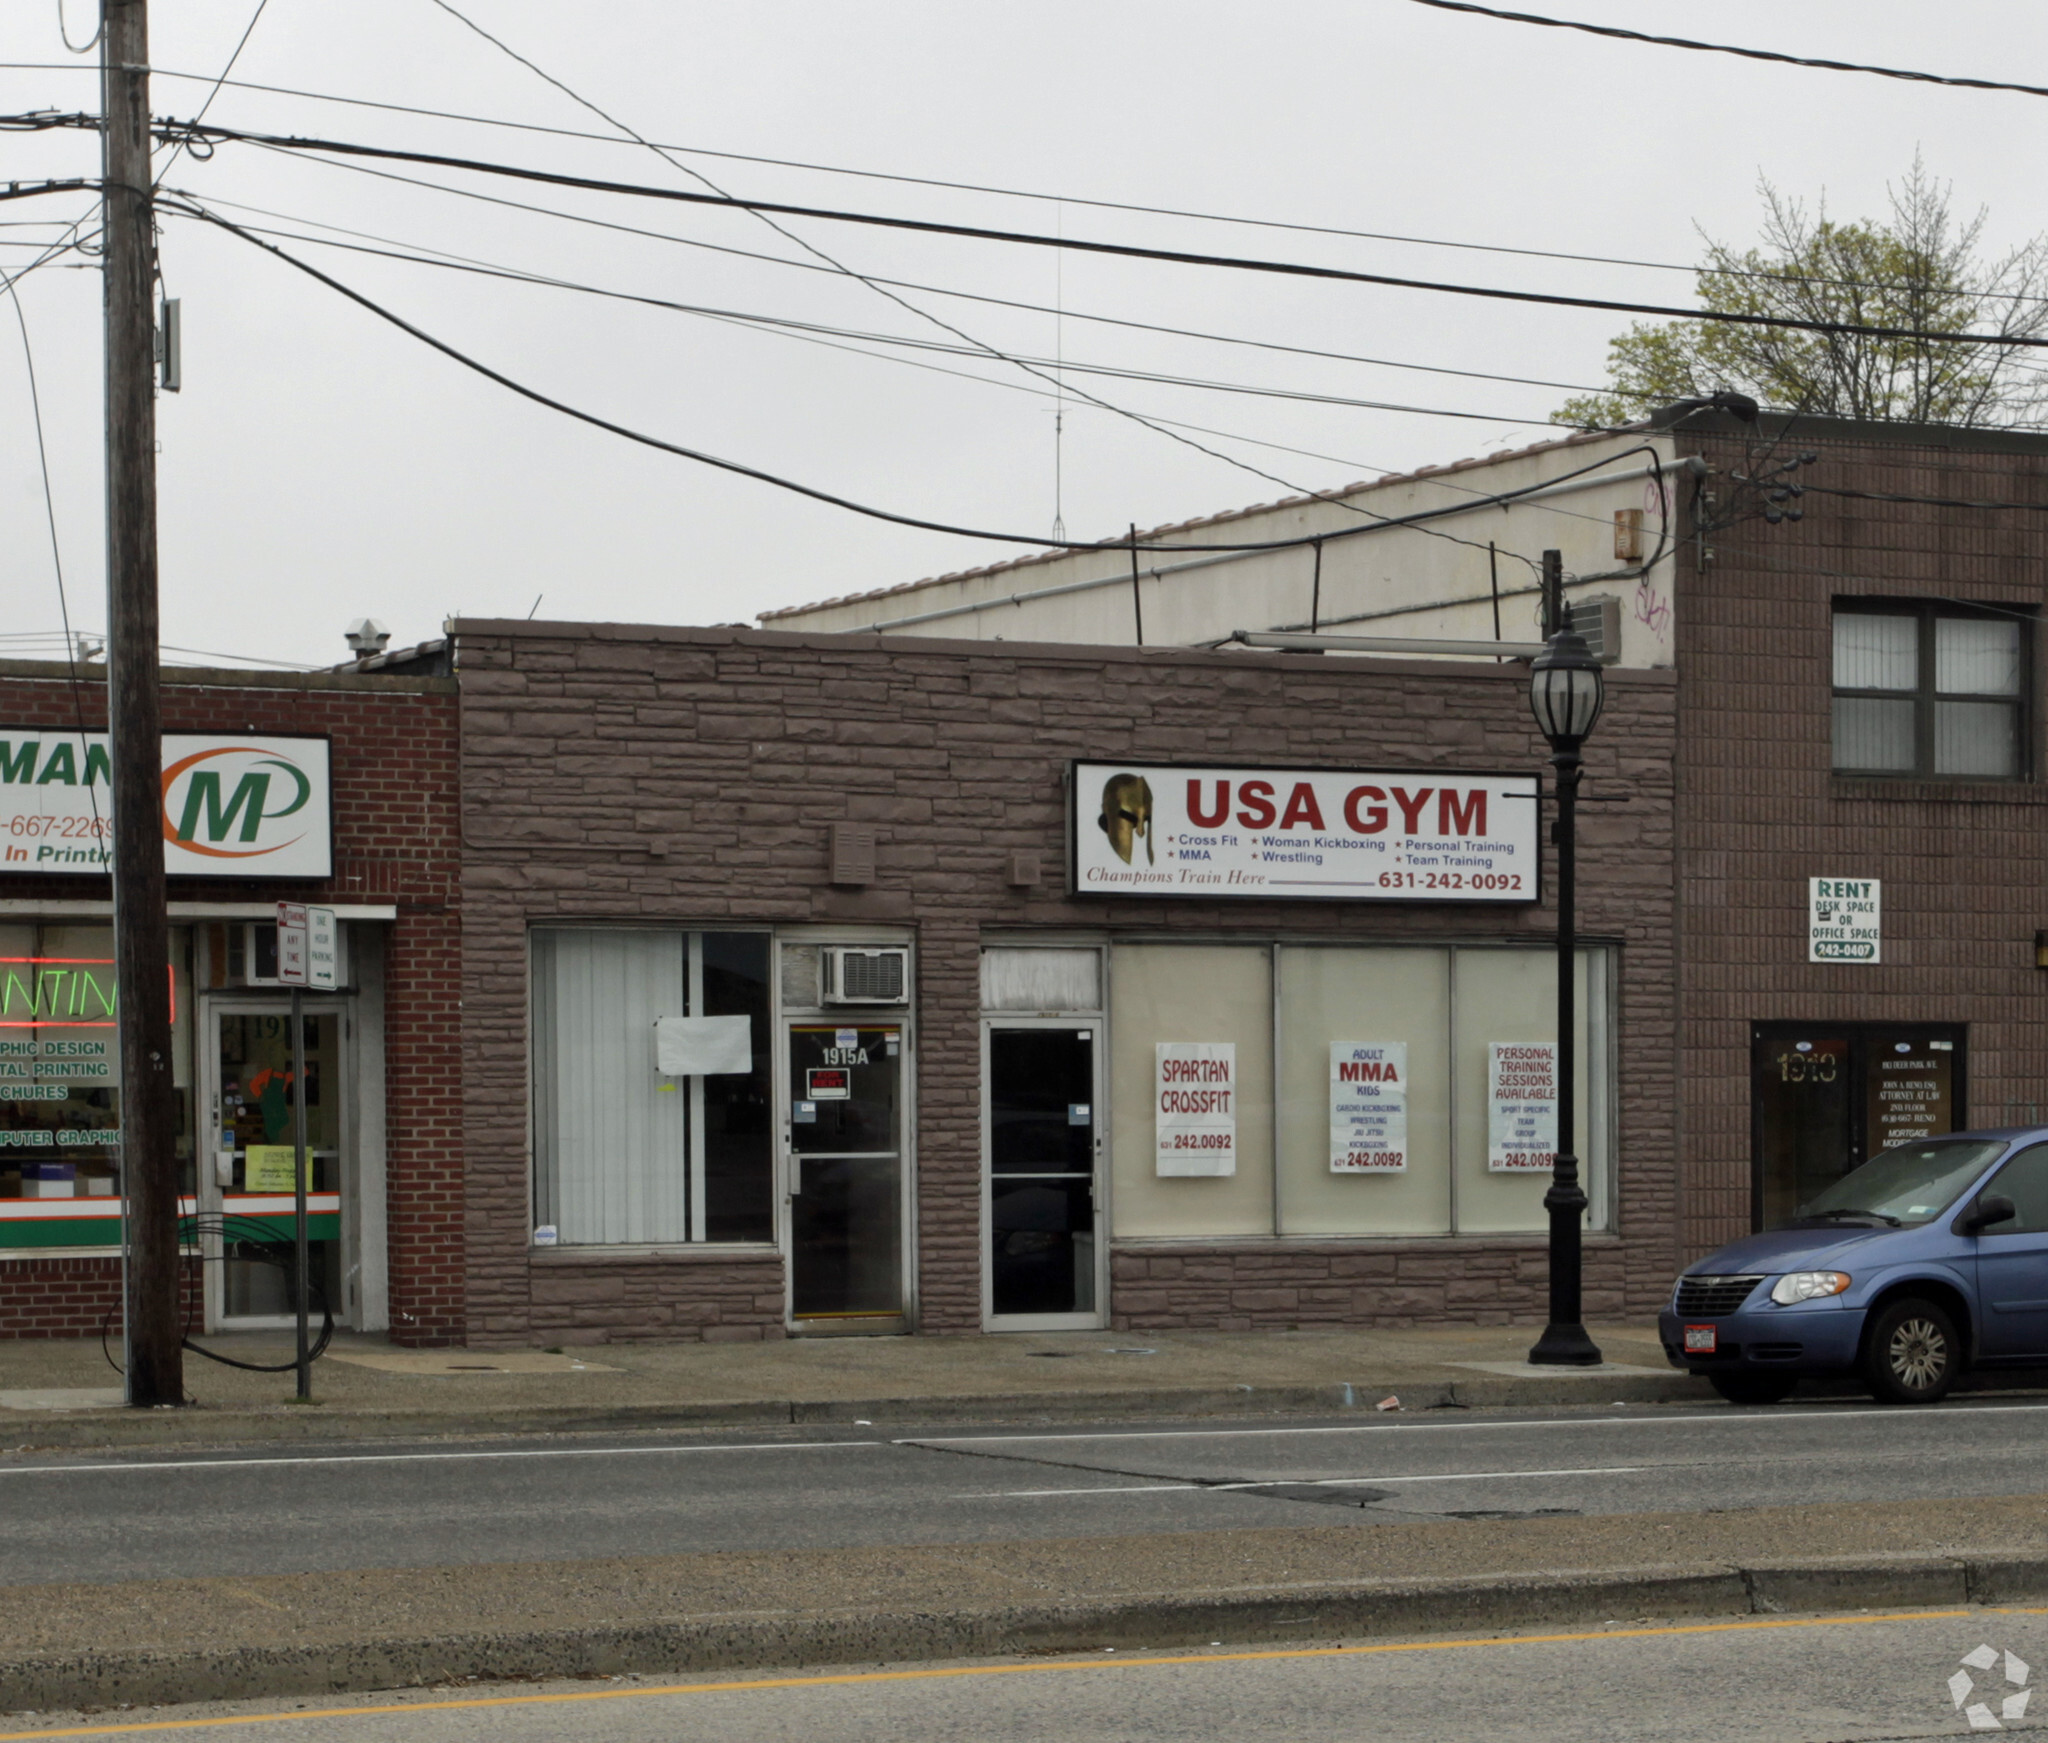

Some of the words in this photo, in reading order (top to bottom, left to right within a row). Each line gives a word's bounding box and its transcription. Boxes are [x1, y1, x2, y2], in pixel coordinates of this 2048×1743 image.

[1186, 779, 1326, 831] USA
[1343, 785, 1488, 837] GYM
[1179, 834, 1217, 846] Cross
[1222, 834, 1238, 846] Fit
[1262, 836, 1311, 848] Woman
[1314, 837, 1386, 852] Kickboxing
[1405, 839, 1460, 851] Personal
[1464, 841, 1514, 854] Training
[5, 844, 28, 861] In
[1179, 849, 1212, 860] MMA
[1262, 851, 1323, 865] Wrestling
[1406, 854, 1438, 866] Team
[1442, 855, 1493, 869] Training
[1087, 867, 1174, 885] Champions
[1179, 869, 1222, 884] Train
[1227, 870, 1266, 885] Here
[1378, 872, 1522, 890] 631-242-0092
[1818, 881, 1872, 898] RENT
[1815, 900, 1841, 911] DESK
[1846, 901, 1874, 913] SPACE
[1839, 915, 1852, 926] OR
[1812, 927, 1844, 938] OFFICE
[1850, 928, 1878, 939] SPACE
[1818, 943, 1872, 956] 242-0407
[0, 1042, 38, 1055] PHIC
[45, 1042, 105, 1055] DESIGN
[1353, 1049, 1384, 1060] ADULT
[1496, 1048, 1554, 1060] PERSONAL
[822, 1047, 869, 1065] 1915A
[0, 1063, 27, 1076] TAL
[34, 1063, 109, 1076] PRINTING
[1162, 1059, 1229, 1082] SPARTAN
[1339, 1062, 1398, 1082] MMA
[1499, 1061, 1552, 1073] TRAINING
[812, 1078, 844, 1087] RENT
[1498, 1074, 1553, 1086] SESSIONS
[0, 1085, 68, 1099] CHURES
[1356, 1085, 1380, 1096] KIDS
[1495, 1088, 1556, 1099] AVAILABLE
[1879, 1091, 1914, 1100] ATTORNEY
[1916, 1091, 1925, 1100] AT
[1926, 1091, 1941, 1100] LAW
[1161, 1090, 1231, 1113] CROSSFIT
[1336, 1104, 1361, 1112] CARDIO
[1362, 1104, 1401, 1112] KICKBOXING
[1501, 1106, 1521, 1114] SPORT
[1523, 1106, 1551, 1114] SPECIFIC
[1353, 1128, 1364, 1136] JIU
[1365, 1128, 1384, 1136] JITSU
[1888, 1129, 1929, 1137] MORTGAGE
[1160, 1141, 1172, 1149] 631
[1174, 1134, 1231, 1149] 242.0092
[1349, 1141, 1388, 1149] KICKBOXING
[1347, 1152, 1403, 1167] 242.0092
